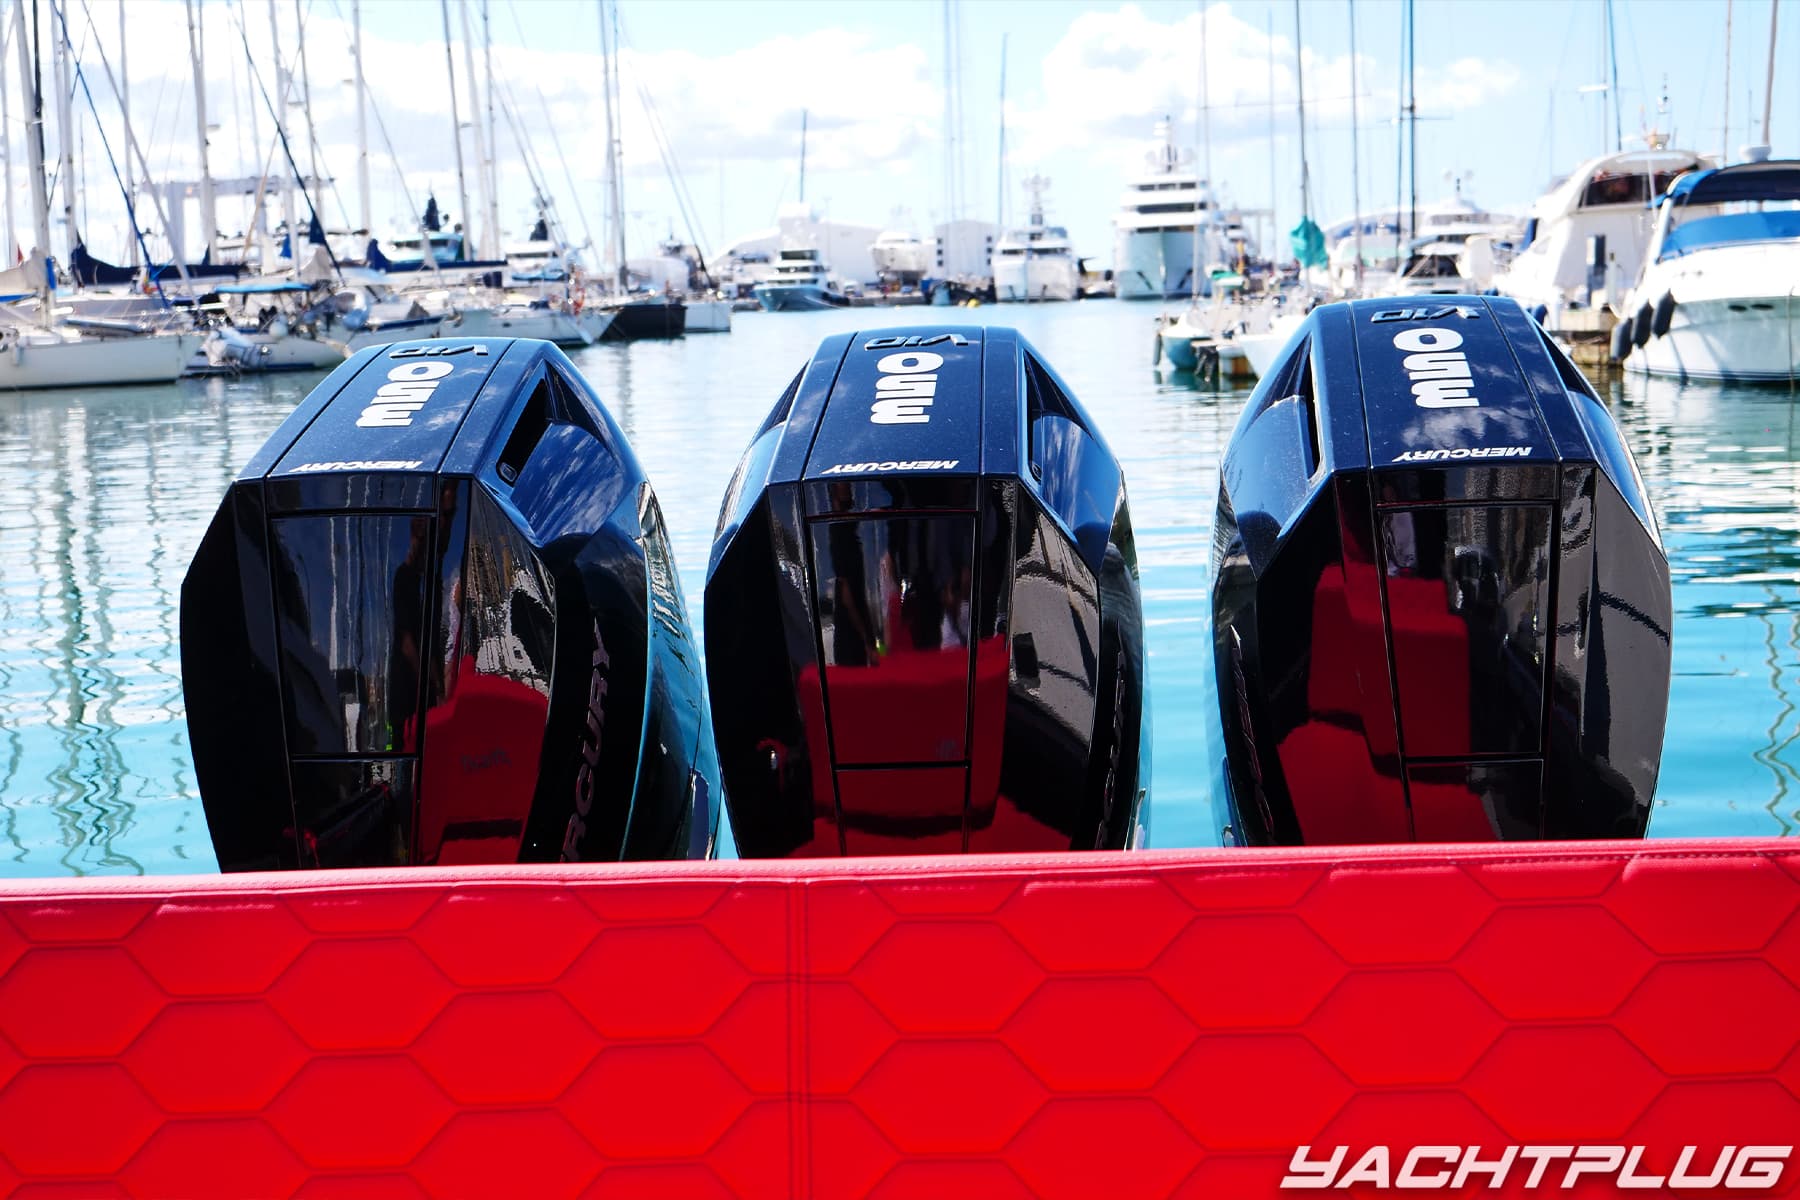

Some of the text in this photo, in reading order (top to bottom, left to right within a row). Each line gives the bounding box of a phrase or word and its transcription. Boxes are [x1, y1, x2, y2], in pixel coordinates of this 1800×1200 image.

[356, 361, 453, 427] 350
[870, 352, 943, 424] 350
[1393, 328, 1480, 409] 350
[289, 460, 423, 473] MERCURY
[821, 460, 960, 474] MERCURY
[1392, 446, 1532, 463] MERCURY
[560, 616, 610, 862] RCURY
